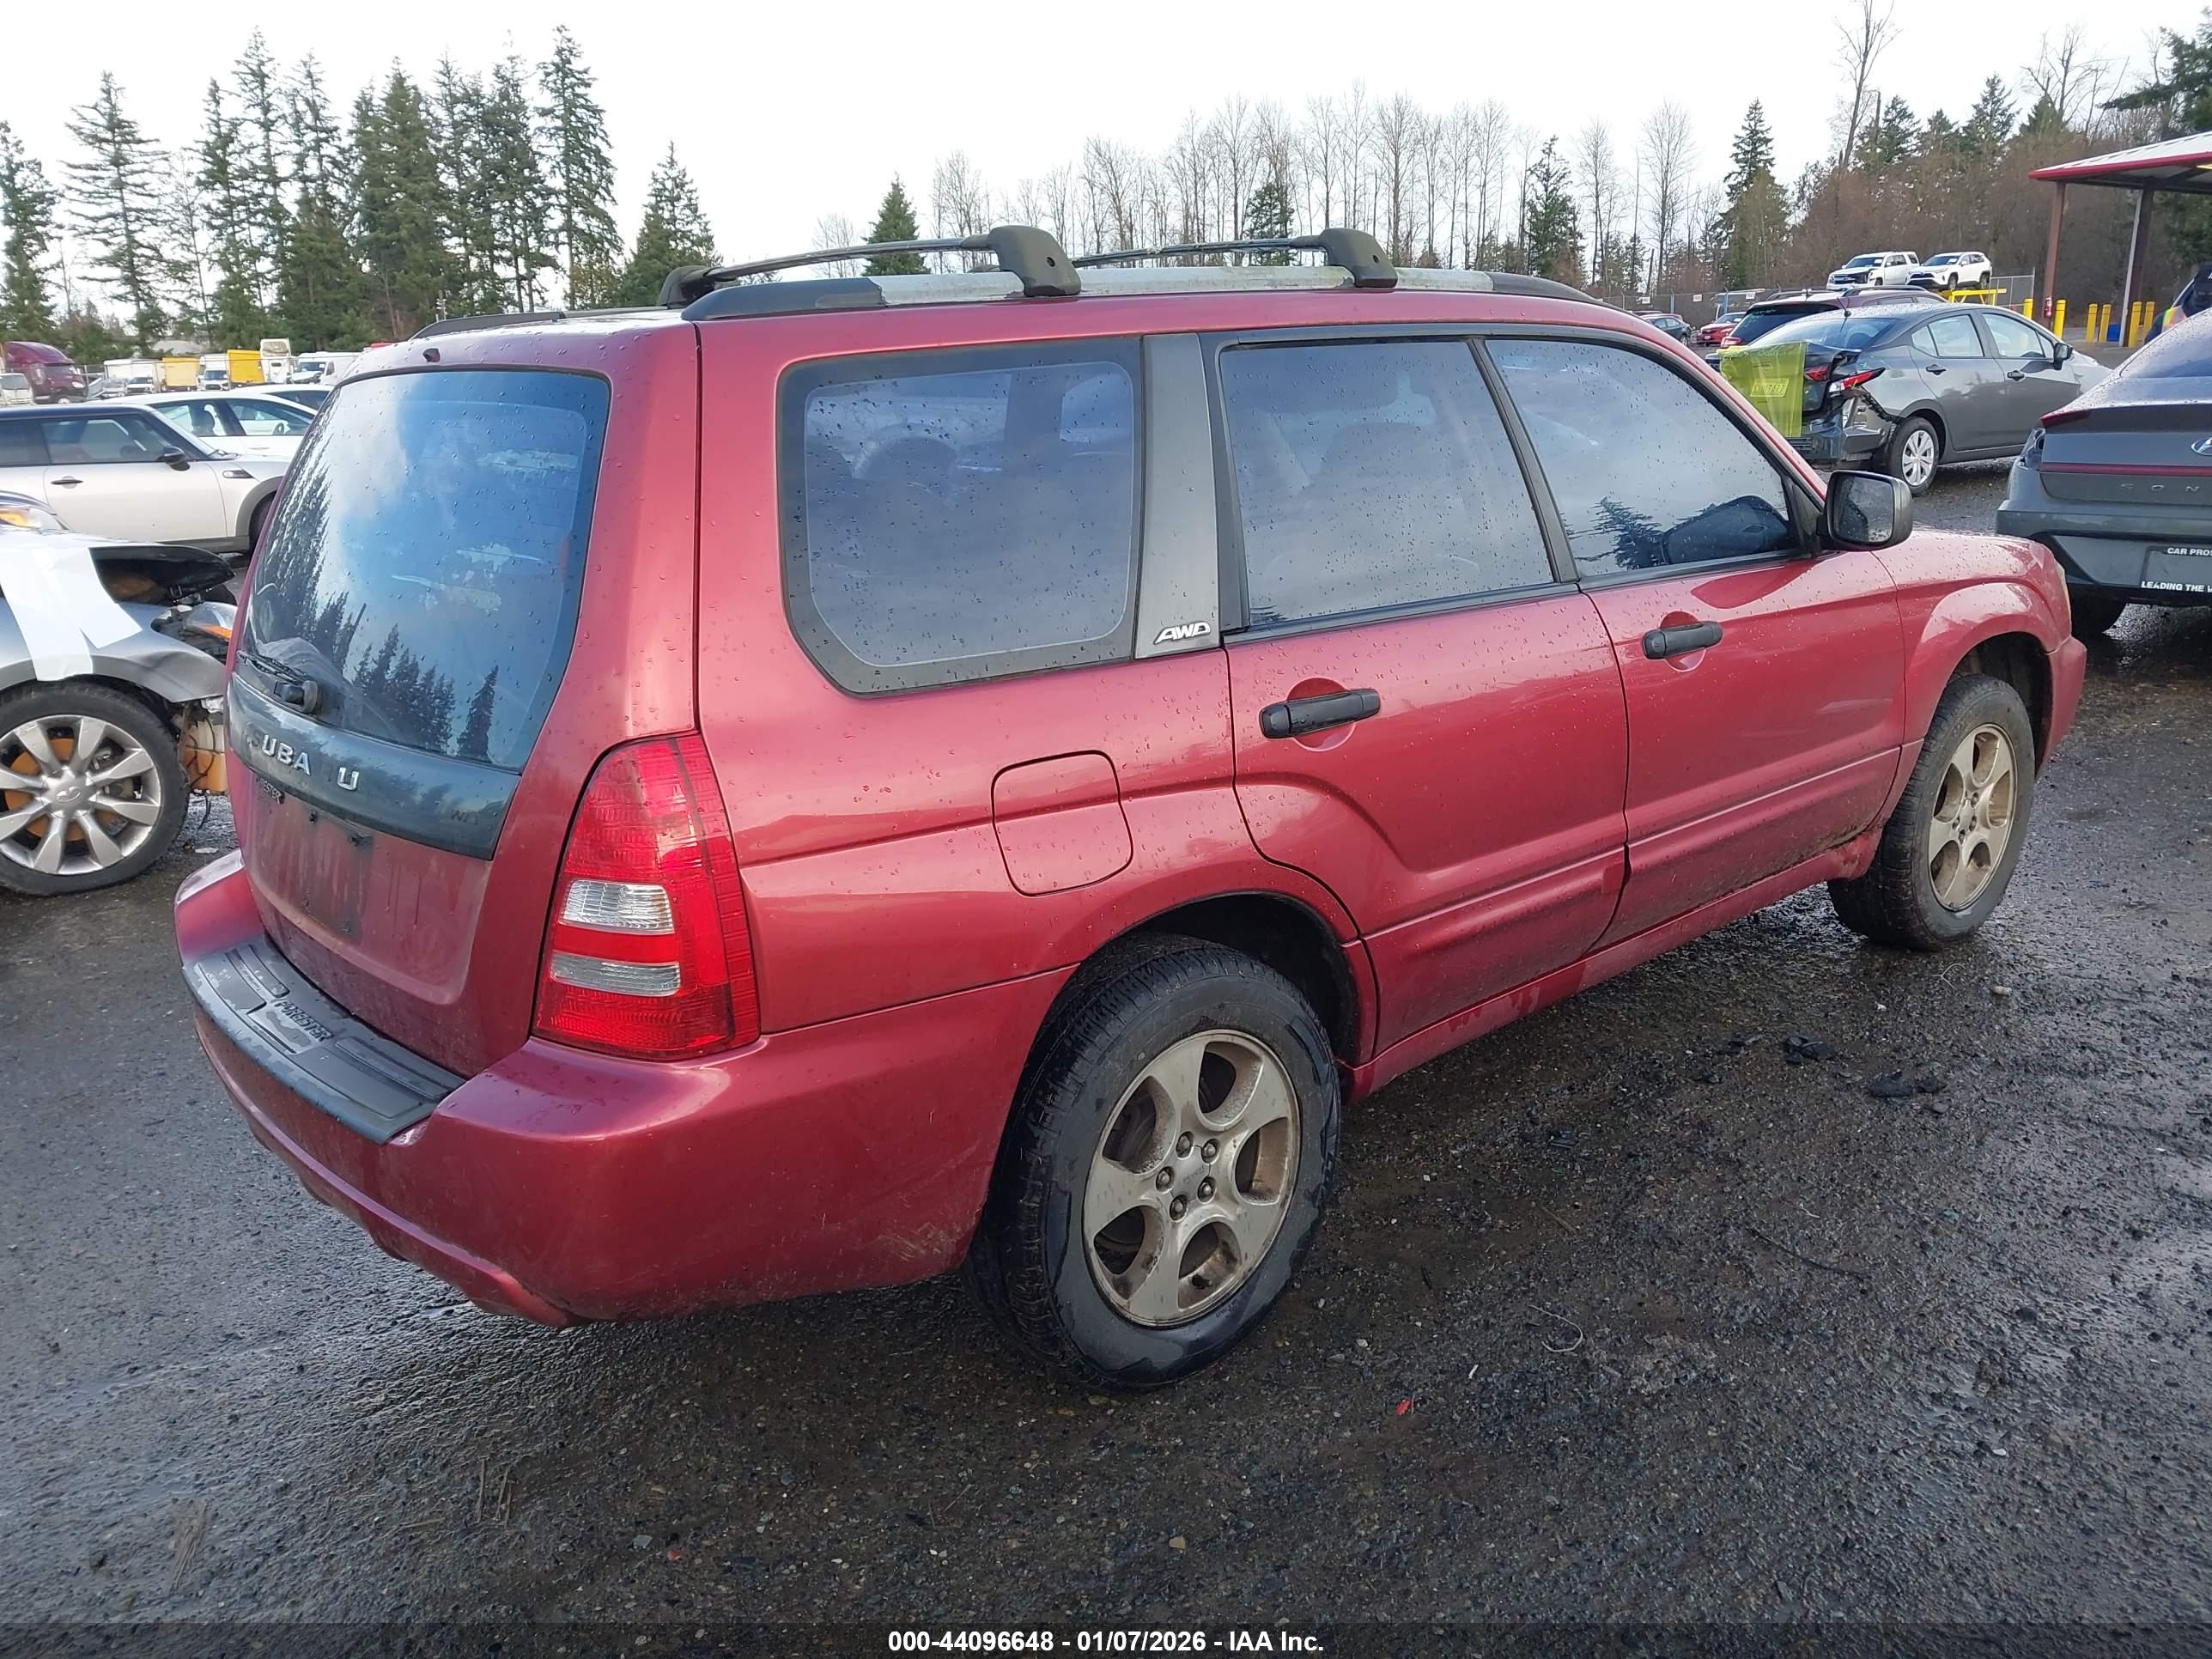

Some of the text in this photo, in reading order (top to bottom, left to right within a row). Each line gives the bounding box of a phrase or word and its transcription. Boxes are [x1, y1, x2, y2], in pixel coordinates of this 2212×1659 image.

[2141, 580, 2183, 591] LEADING
[2185, 584, 2205, 592] THE
[1154, 622, 1211, 645] AWD
[274, 1001, 335, 1042] FORESTER
